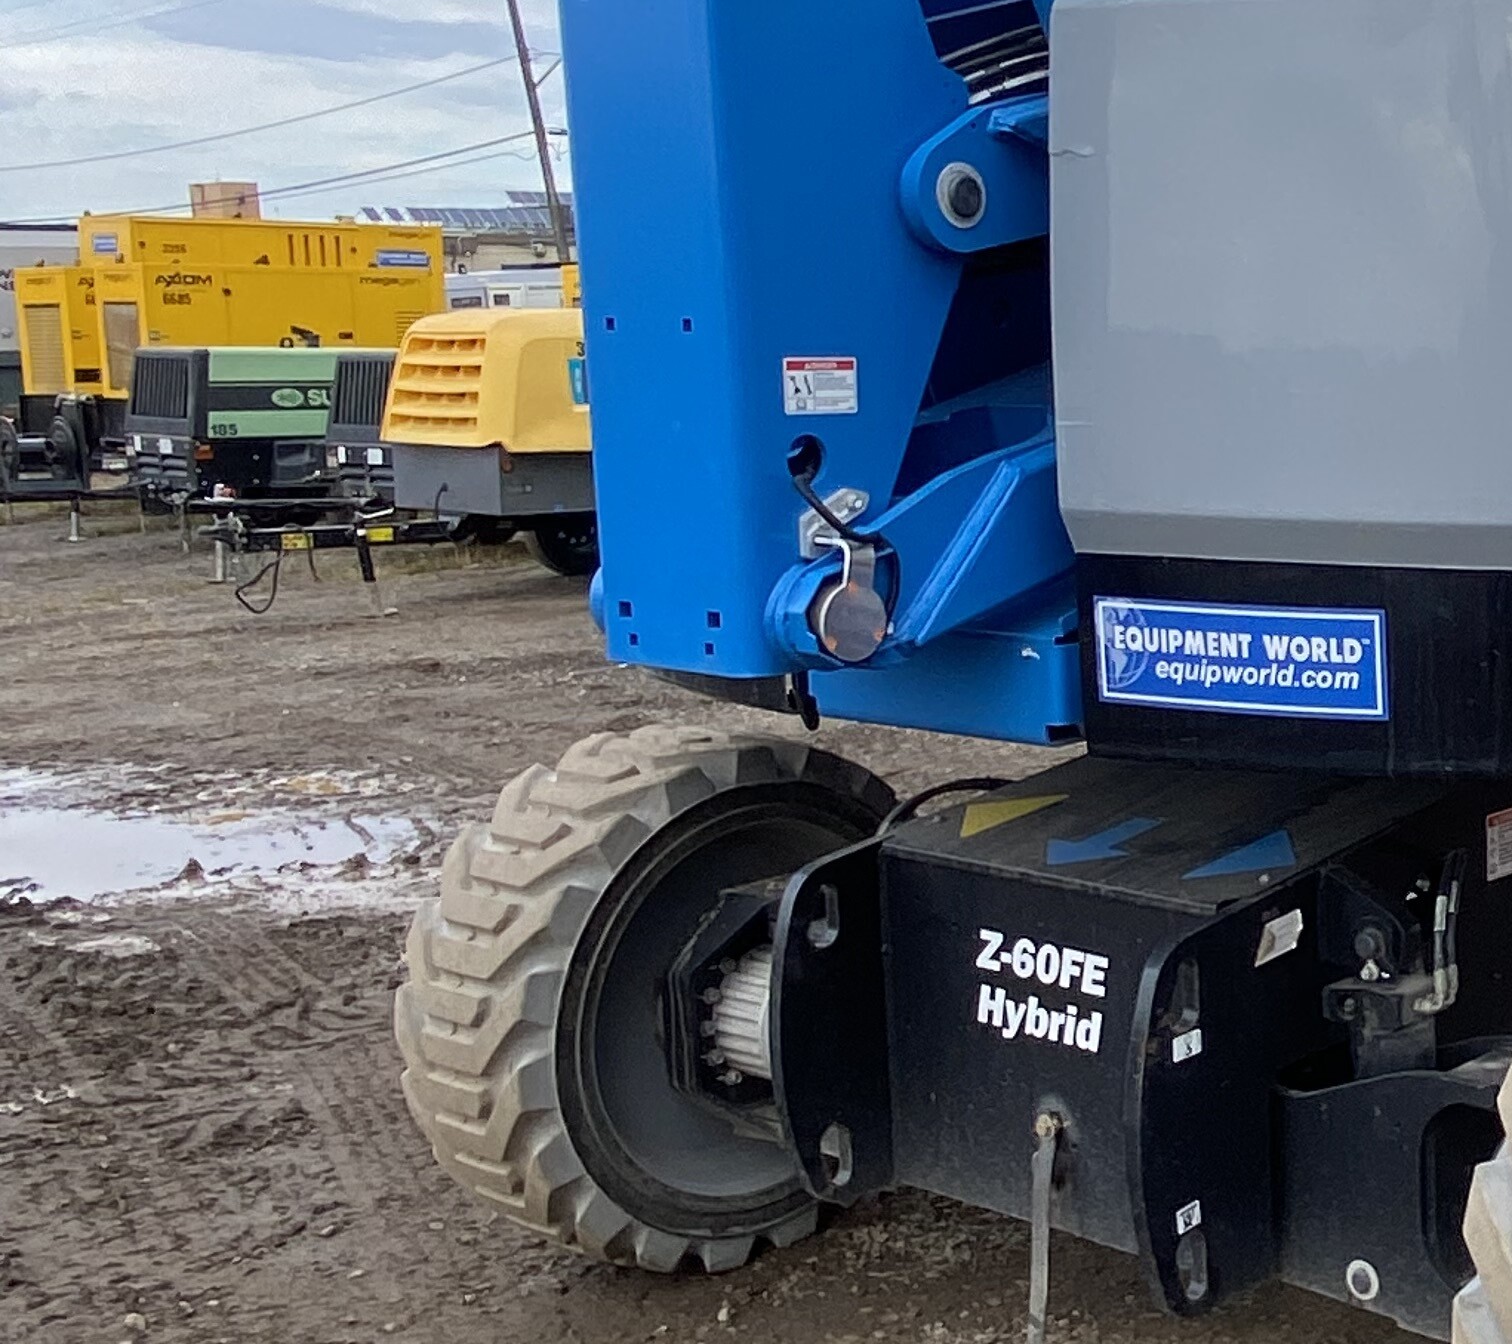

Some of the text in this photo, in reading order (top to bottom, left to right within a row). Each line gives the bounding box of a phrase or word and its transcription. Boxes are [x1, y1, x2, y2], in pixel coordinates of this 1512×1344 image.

[1112, 625, 1363, 664] EQUIPMENT WORLD
[1155, 659, 1360, 690] equipworld.com
[975, 928, 1109, 997] Z-60FE
[977, 984, 1103, 1053] Hybrid
